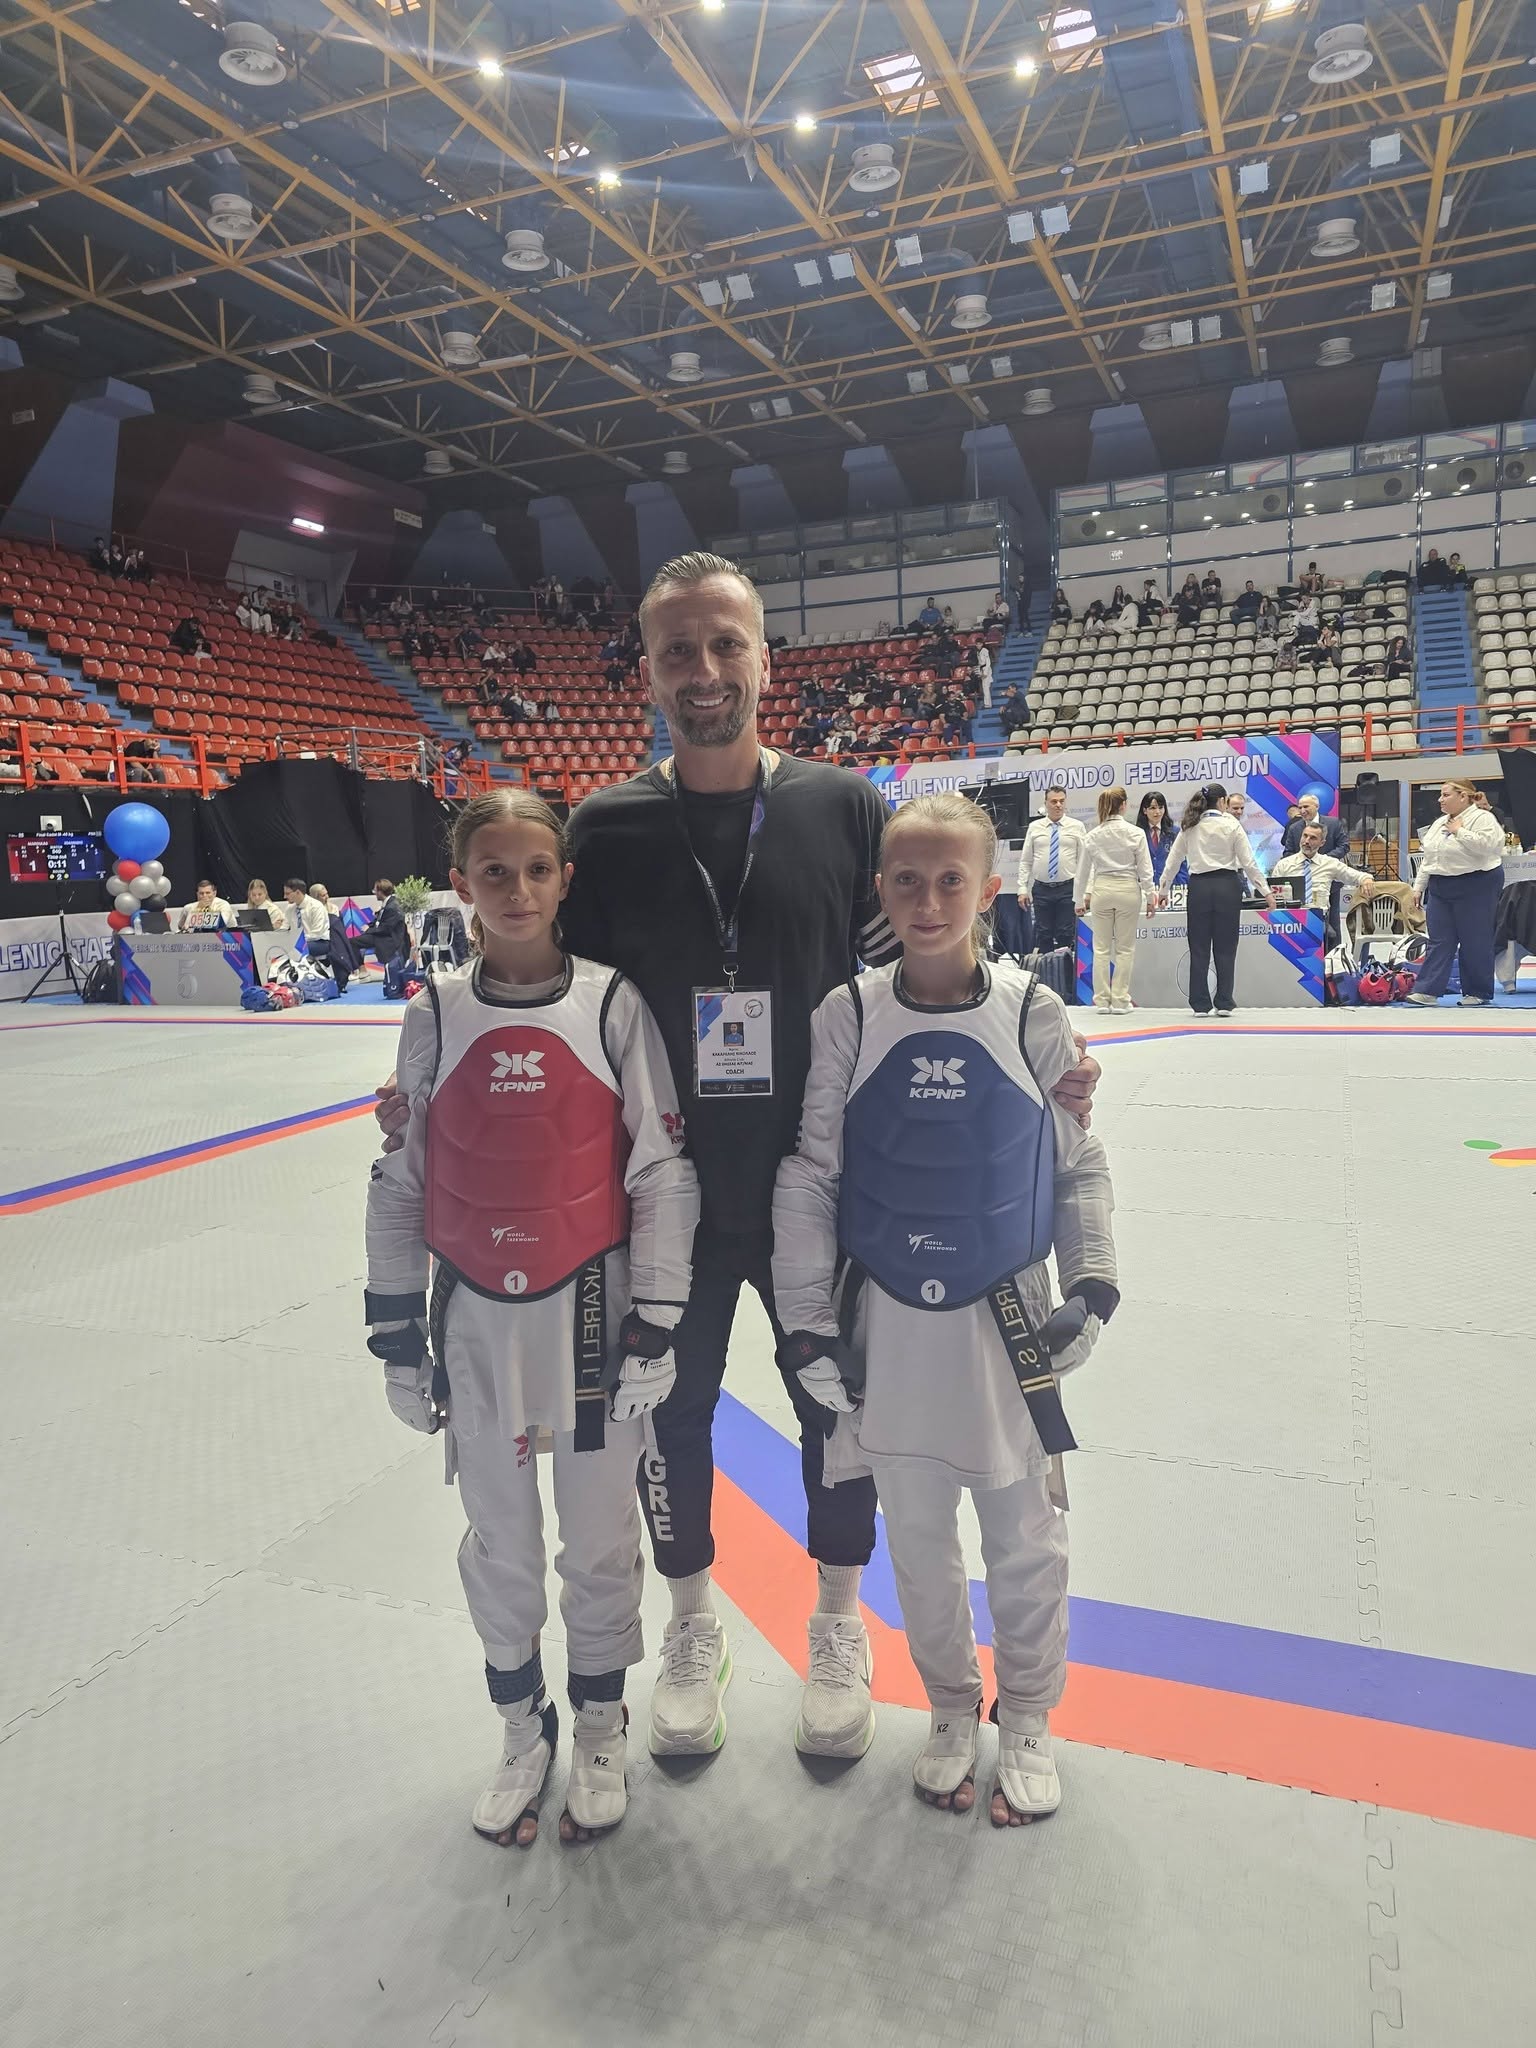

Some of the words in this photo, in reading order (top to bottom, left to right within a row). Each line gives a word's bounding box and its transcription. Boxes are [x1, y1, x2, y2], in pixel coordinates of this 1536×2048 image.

[878, 776, 966, 801] HELLENIC
[977, 764, 1115, 792] WONDO
[1125, 754, 1269, 786] FEDERATION
[29, 860, 36, 871] 1
[48, 860, 67, 868] 0:11
[79, 859, 85, 870] 1
[205, 914, 218, 925] 37
[1238, 923, 1302, 936] EDERATION
[490, 1081, 546, 1093] KPNP
[909, 1087, 967, 1100] KPNP
[510, 1275, 519, 1290] 1
[927, 1284, 937, 1299] 1
[644, 1455, 675, 1541] GRE
[937, 1723, 949, 1734] K2
[1024, 1737, 1037, 1749] K2
[505, 1756, 517, 1767] K2
[594, 1755, 609, 1766] K2
